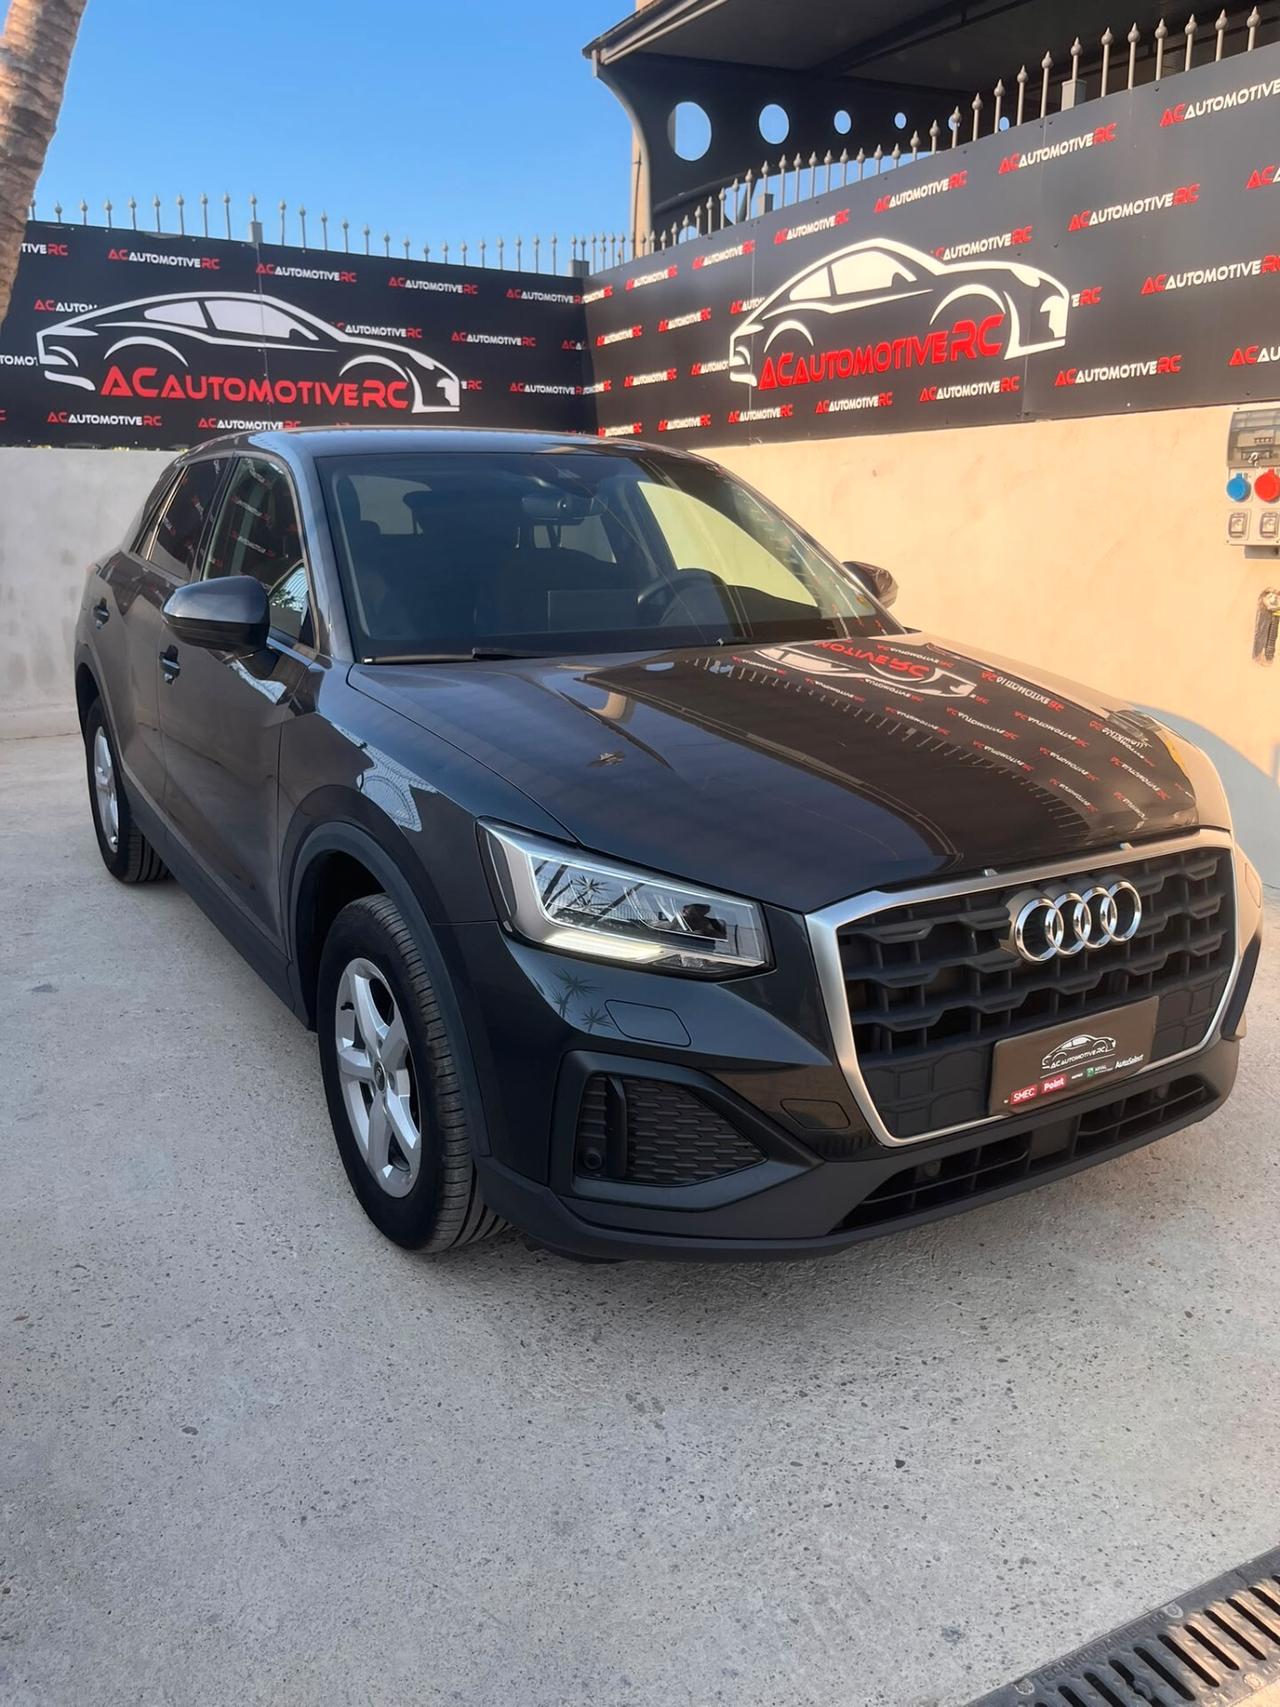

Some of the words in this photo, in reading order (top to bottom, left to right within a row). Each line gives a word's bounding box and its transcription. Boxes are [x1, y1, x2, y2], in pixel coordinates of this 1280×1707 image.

[999, 123, 1117, 174] ACAUTOMOTIVERC
[874, 170, 968, 213] ACAUTOMOTIVERC
[1068, 184, 1200, 231] ACAUTOMOTIVERC
[774, 209, 850, 245] ACAUTOMOTIVERC
[107, 249, 221, 270] ACAUTOMOTIVERC
[256, 263, 357, 283] ACAUTOMOTIVERC
[388, 276, 478, 295] ACAUTOMOTIVERC
[452, 331, 536, 347] ACAUTOMOTIVERC
[758, 314, 1005, 390] ACAUTOMOTIVERC
[1055, 355, 1182, 387] ACAUTOMOTIVERC
[101, 365, 408, 408] ACAUTOMOTIVERC
[919, 376, 1020, 402] ACAUTOMOTIVERC
[728, 404, 793, 424] ACAUTOMOTIVERC
[815, 391, 893, 414] ACAUTOMOTIVERC
[47, 411, 162, 427] ACAUTOMOTIVERC
[1043, 1077, 1065, 1092] Point
